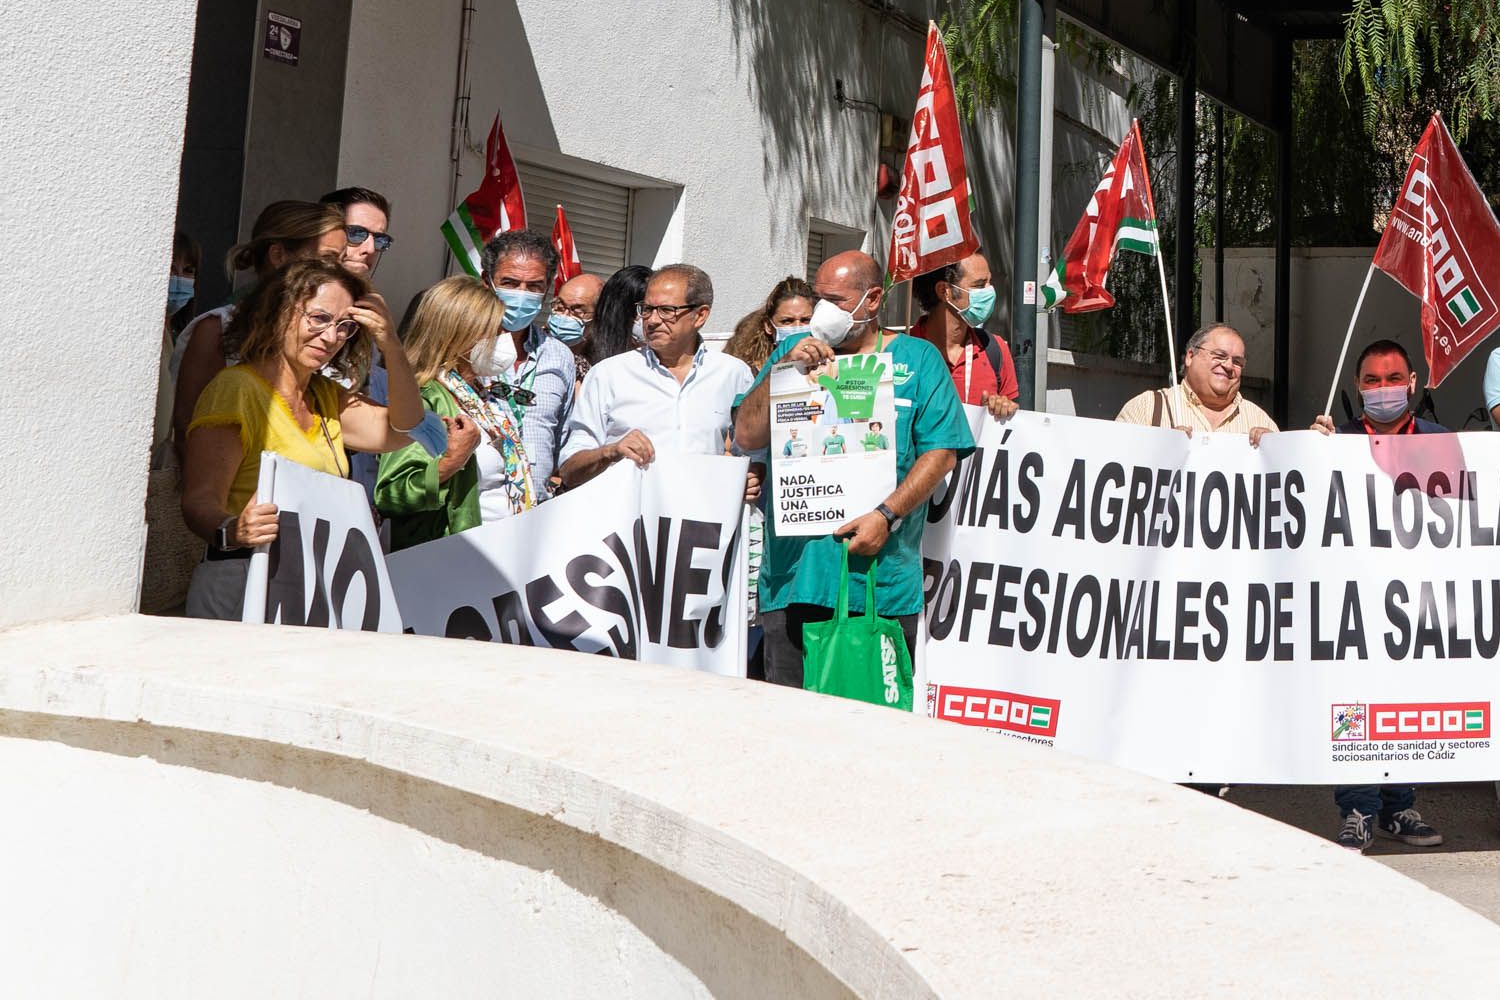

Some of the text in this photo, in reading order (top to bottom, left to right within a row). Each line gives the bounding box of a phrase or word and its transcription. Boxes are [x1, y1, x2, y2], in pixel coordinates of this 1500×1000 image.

[779, 474, 816, 487] NADA
[780, 484, 844, 499] JUSTIFICA
[780, 500, 809, 511] UNA
[1053, 457, 1306, 553] AGRESIONES
[1322, 469, 1354, 549] A
[781, 507, 846, 524] AGRESIÓN
[1244, 580, 1295, 663] DE
[1310, 579, 1369, 662] LA
[943, 693, 1030, 726] CCOO
[1375, 709, 1464, 733] CCOO
[1332, 740, 1491, 752] sindicato de sanidad y sectores
[1332, 750, 1456, 762] sociosanitarios de Cádiz
